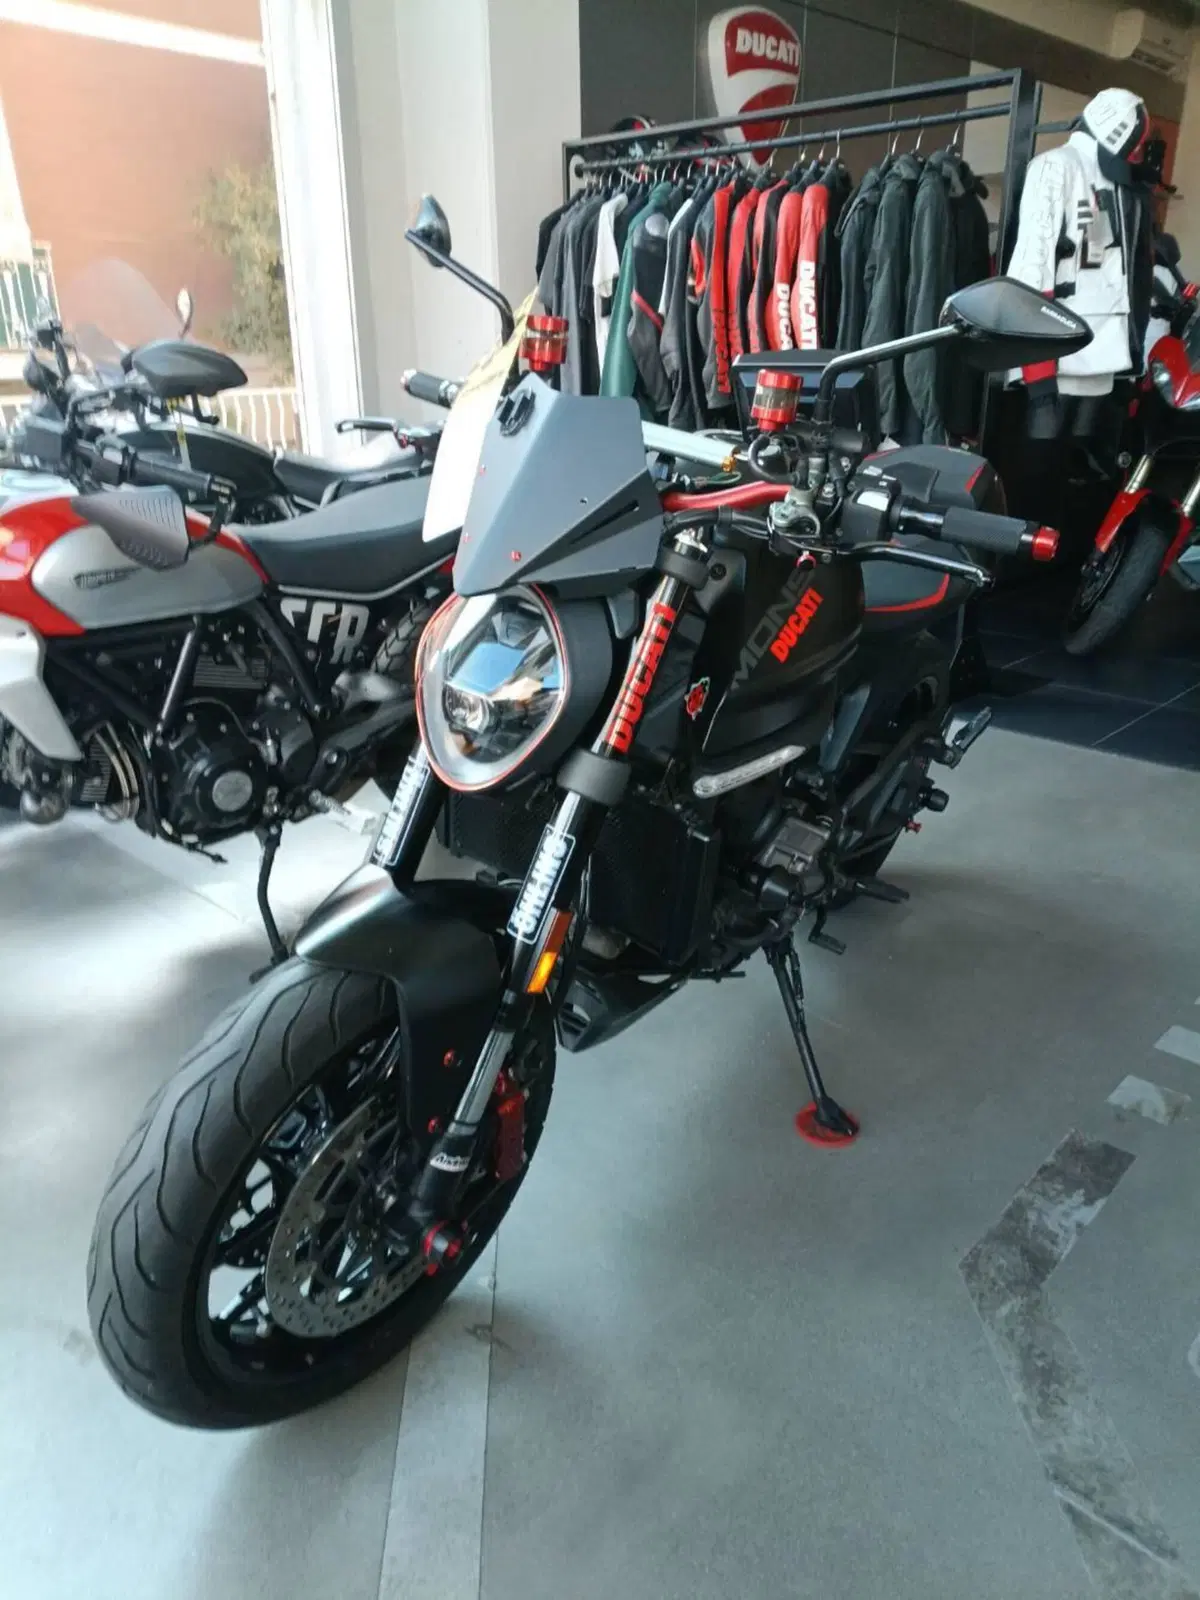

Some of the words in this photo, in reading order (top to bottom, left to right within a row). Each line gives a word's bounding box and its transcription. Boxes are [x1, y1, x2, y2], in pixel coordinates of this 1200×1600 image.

[735, 27, 800, 67] DUCATI
[799, 260, 817, 350] DUCATI
[769, 587, 824, 664] DUCATI
[605, 602, 676, 754] DUCATI
